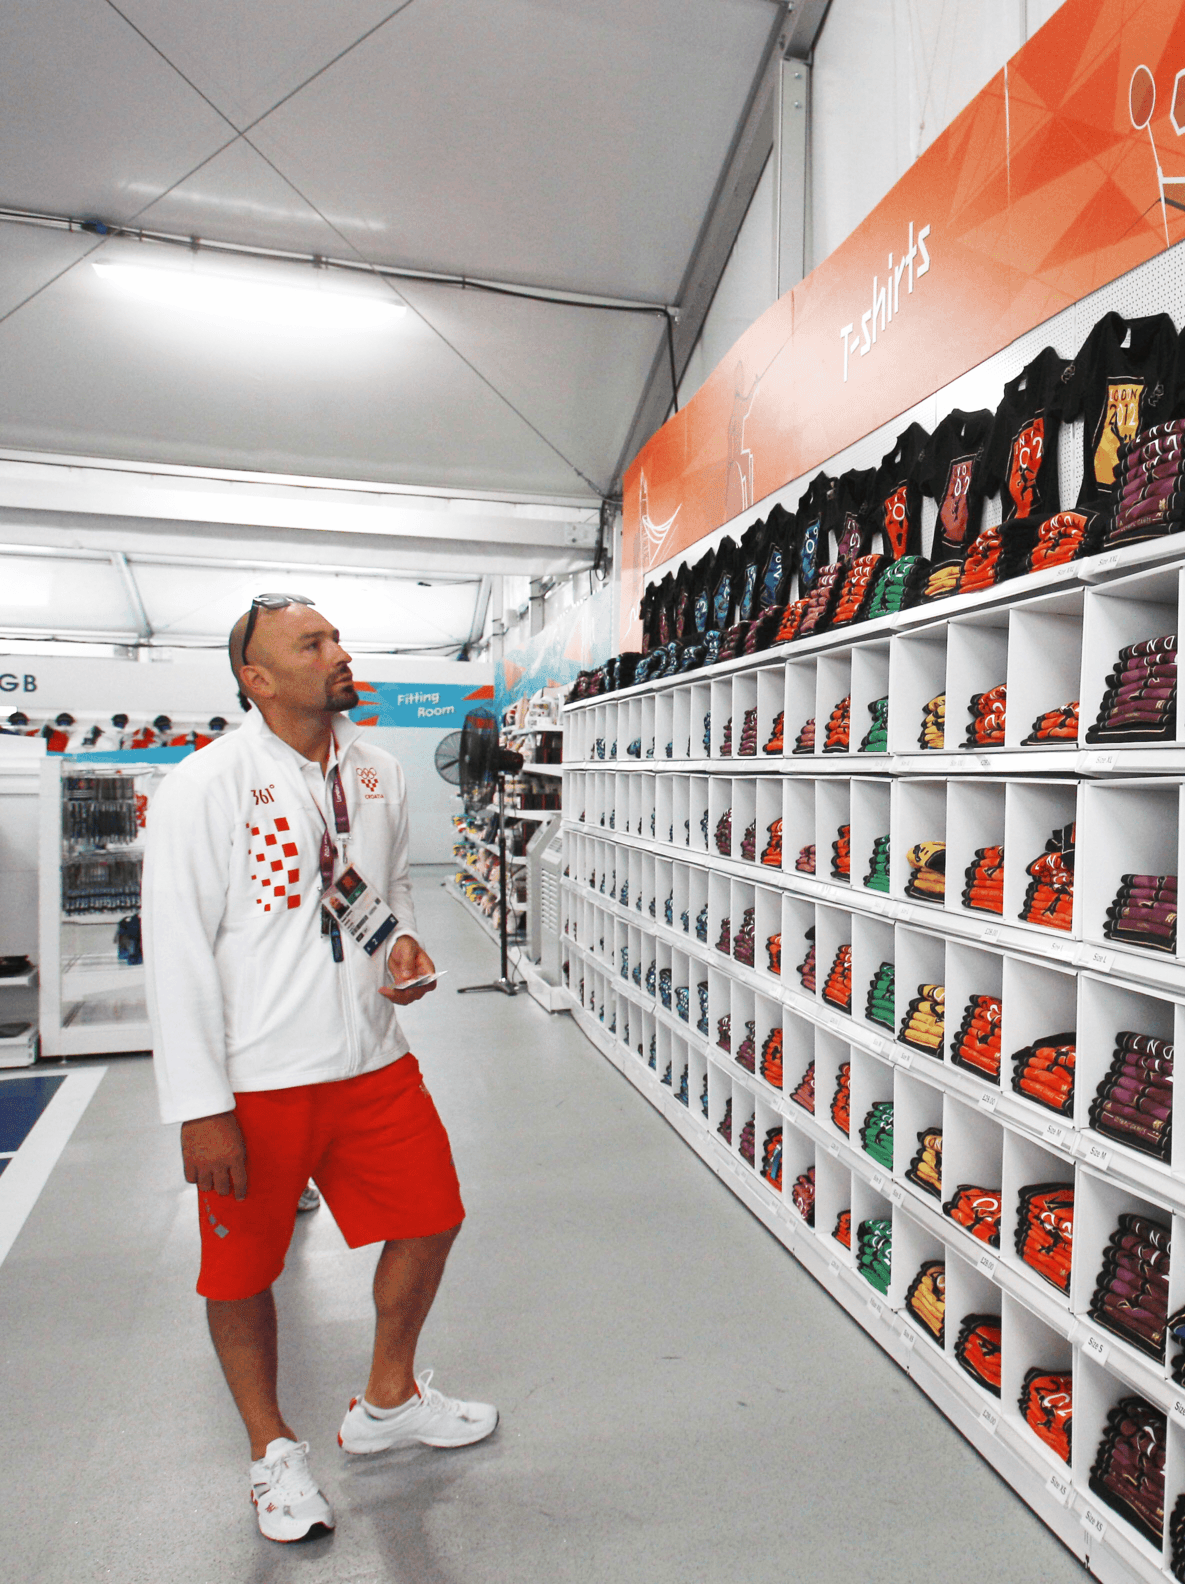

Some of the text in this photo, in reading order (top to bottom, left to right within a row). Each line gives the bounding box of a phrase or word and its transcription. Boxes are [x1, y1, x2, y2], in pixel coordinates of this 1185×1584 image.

[840, 221, 931, 383] T-shirts
[397, 691, 440, 706] Fitting
[417, 705, 455, 718] Room
[1090, 1147, 1101, 1158] Size
[1088, 1337, 1104, 1353] Size S
[1050, 1476, 1068, 1496] Size XS
[1085, 1510, 1104, 1532] Size XS
